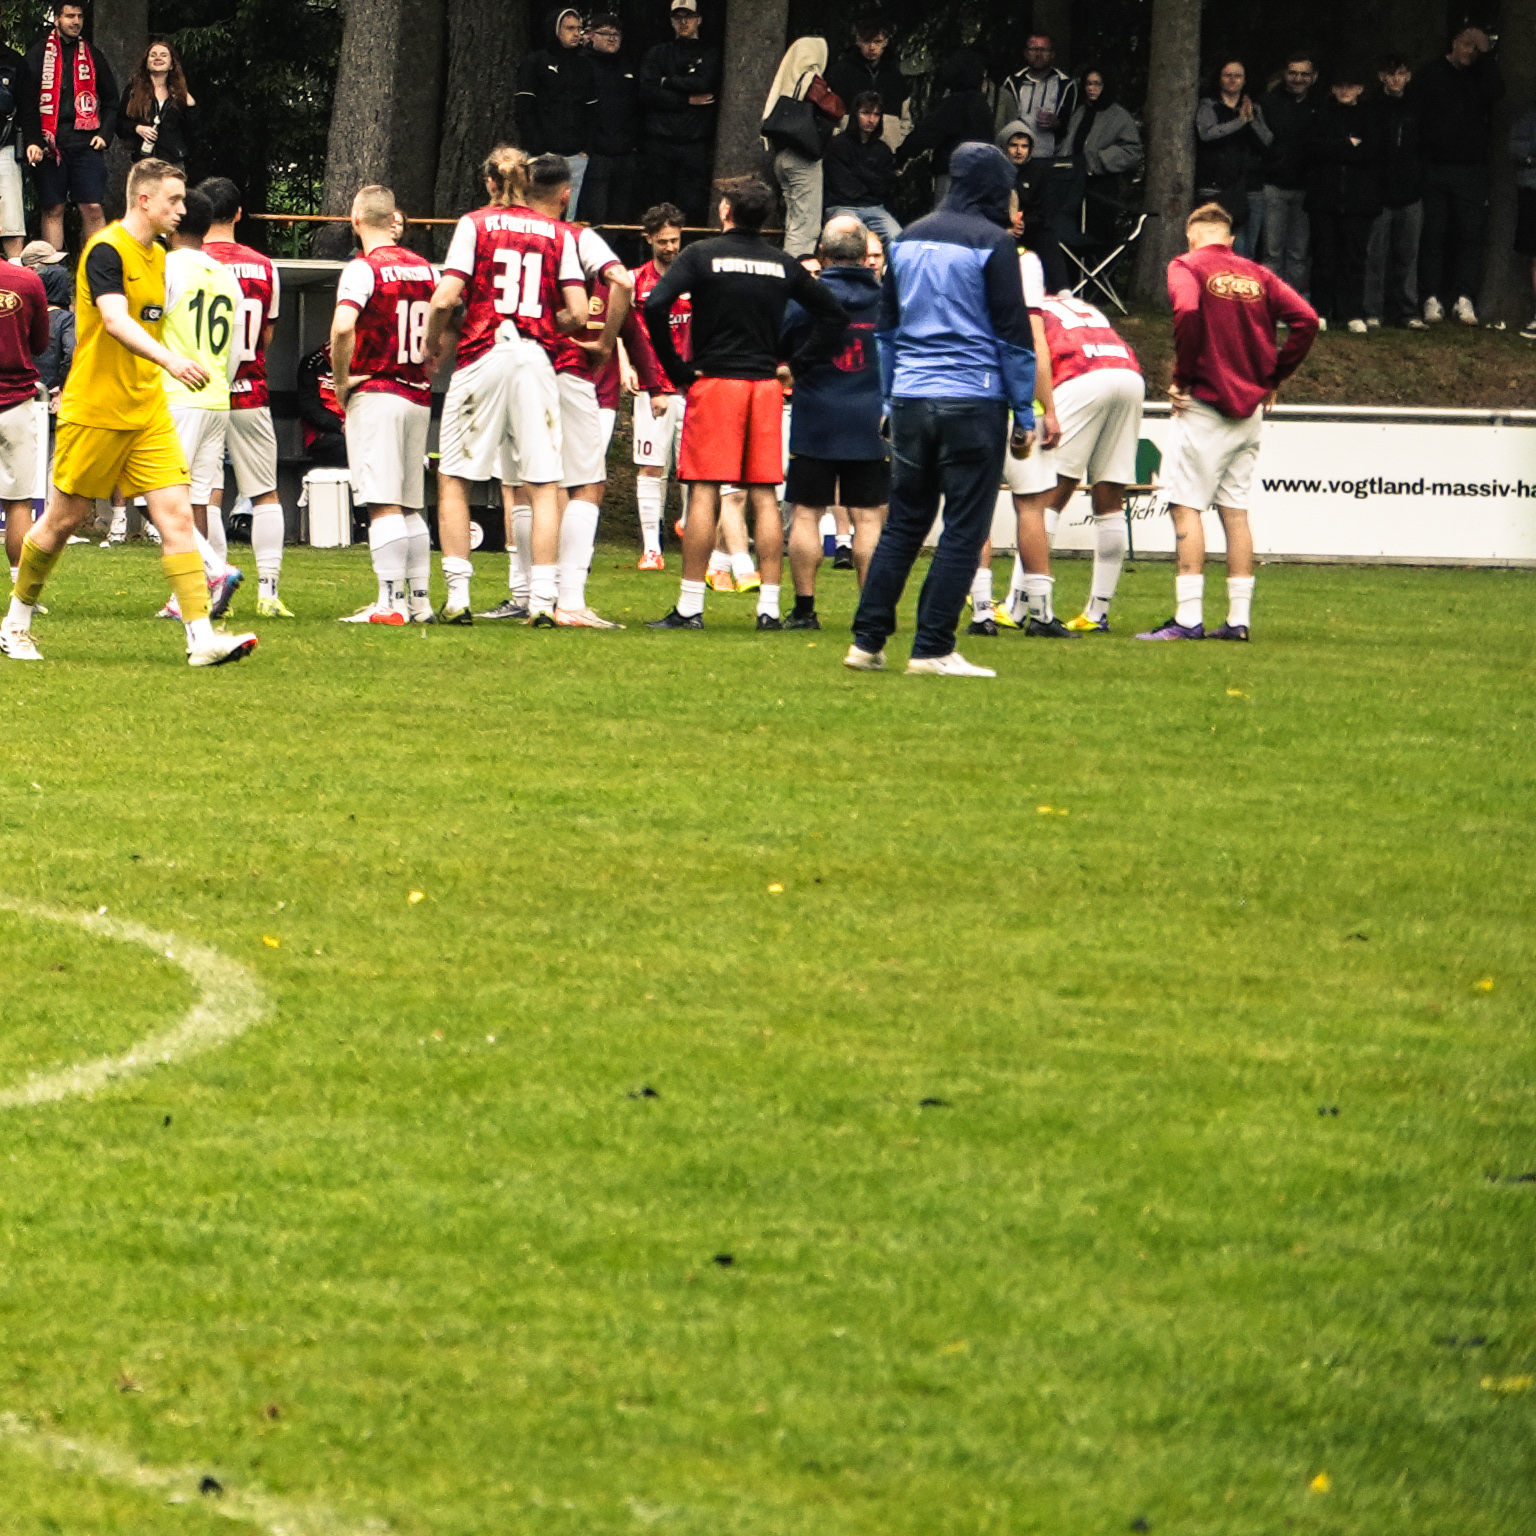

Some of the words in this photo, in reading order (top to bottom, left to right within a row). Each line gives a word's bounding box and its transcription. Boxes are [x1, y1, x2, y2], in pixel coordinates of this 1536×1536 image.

[493, 248, 543, 319] 31
[712, 258, 786, 279] FORTUNA
[188, 289, 233, 355] 16
[395, 300, 431, 364] 18
[637, 439, 653, 456] 10
